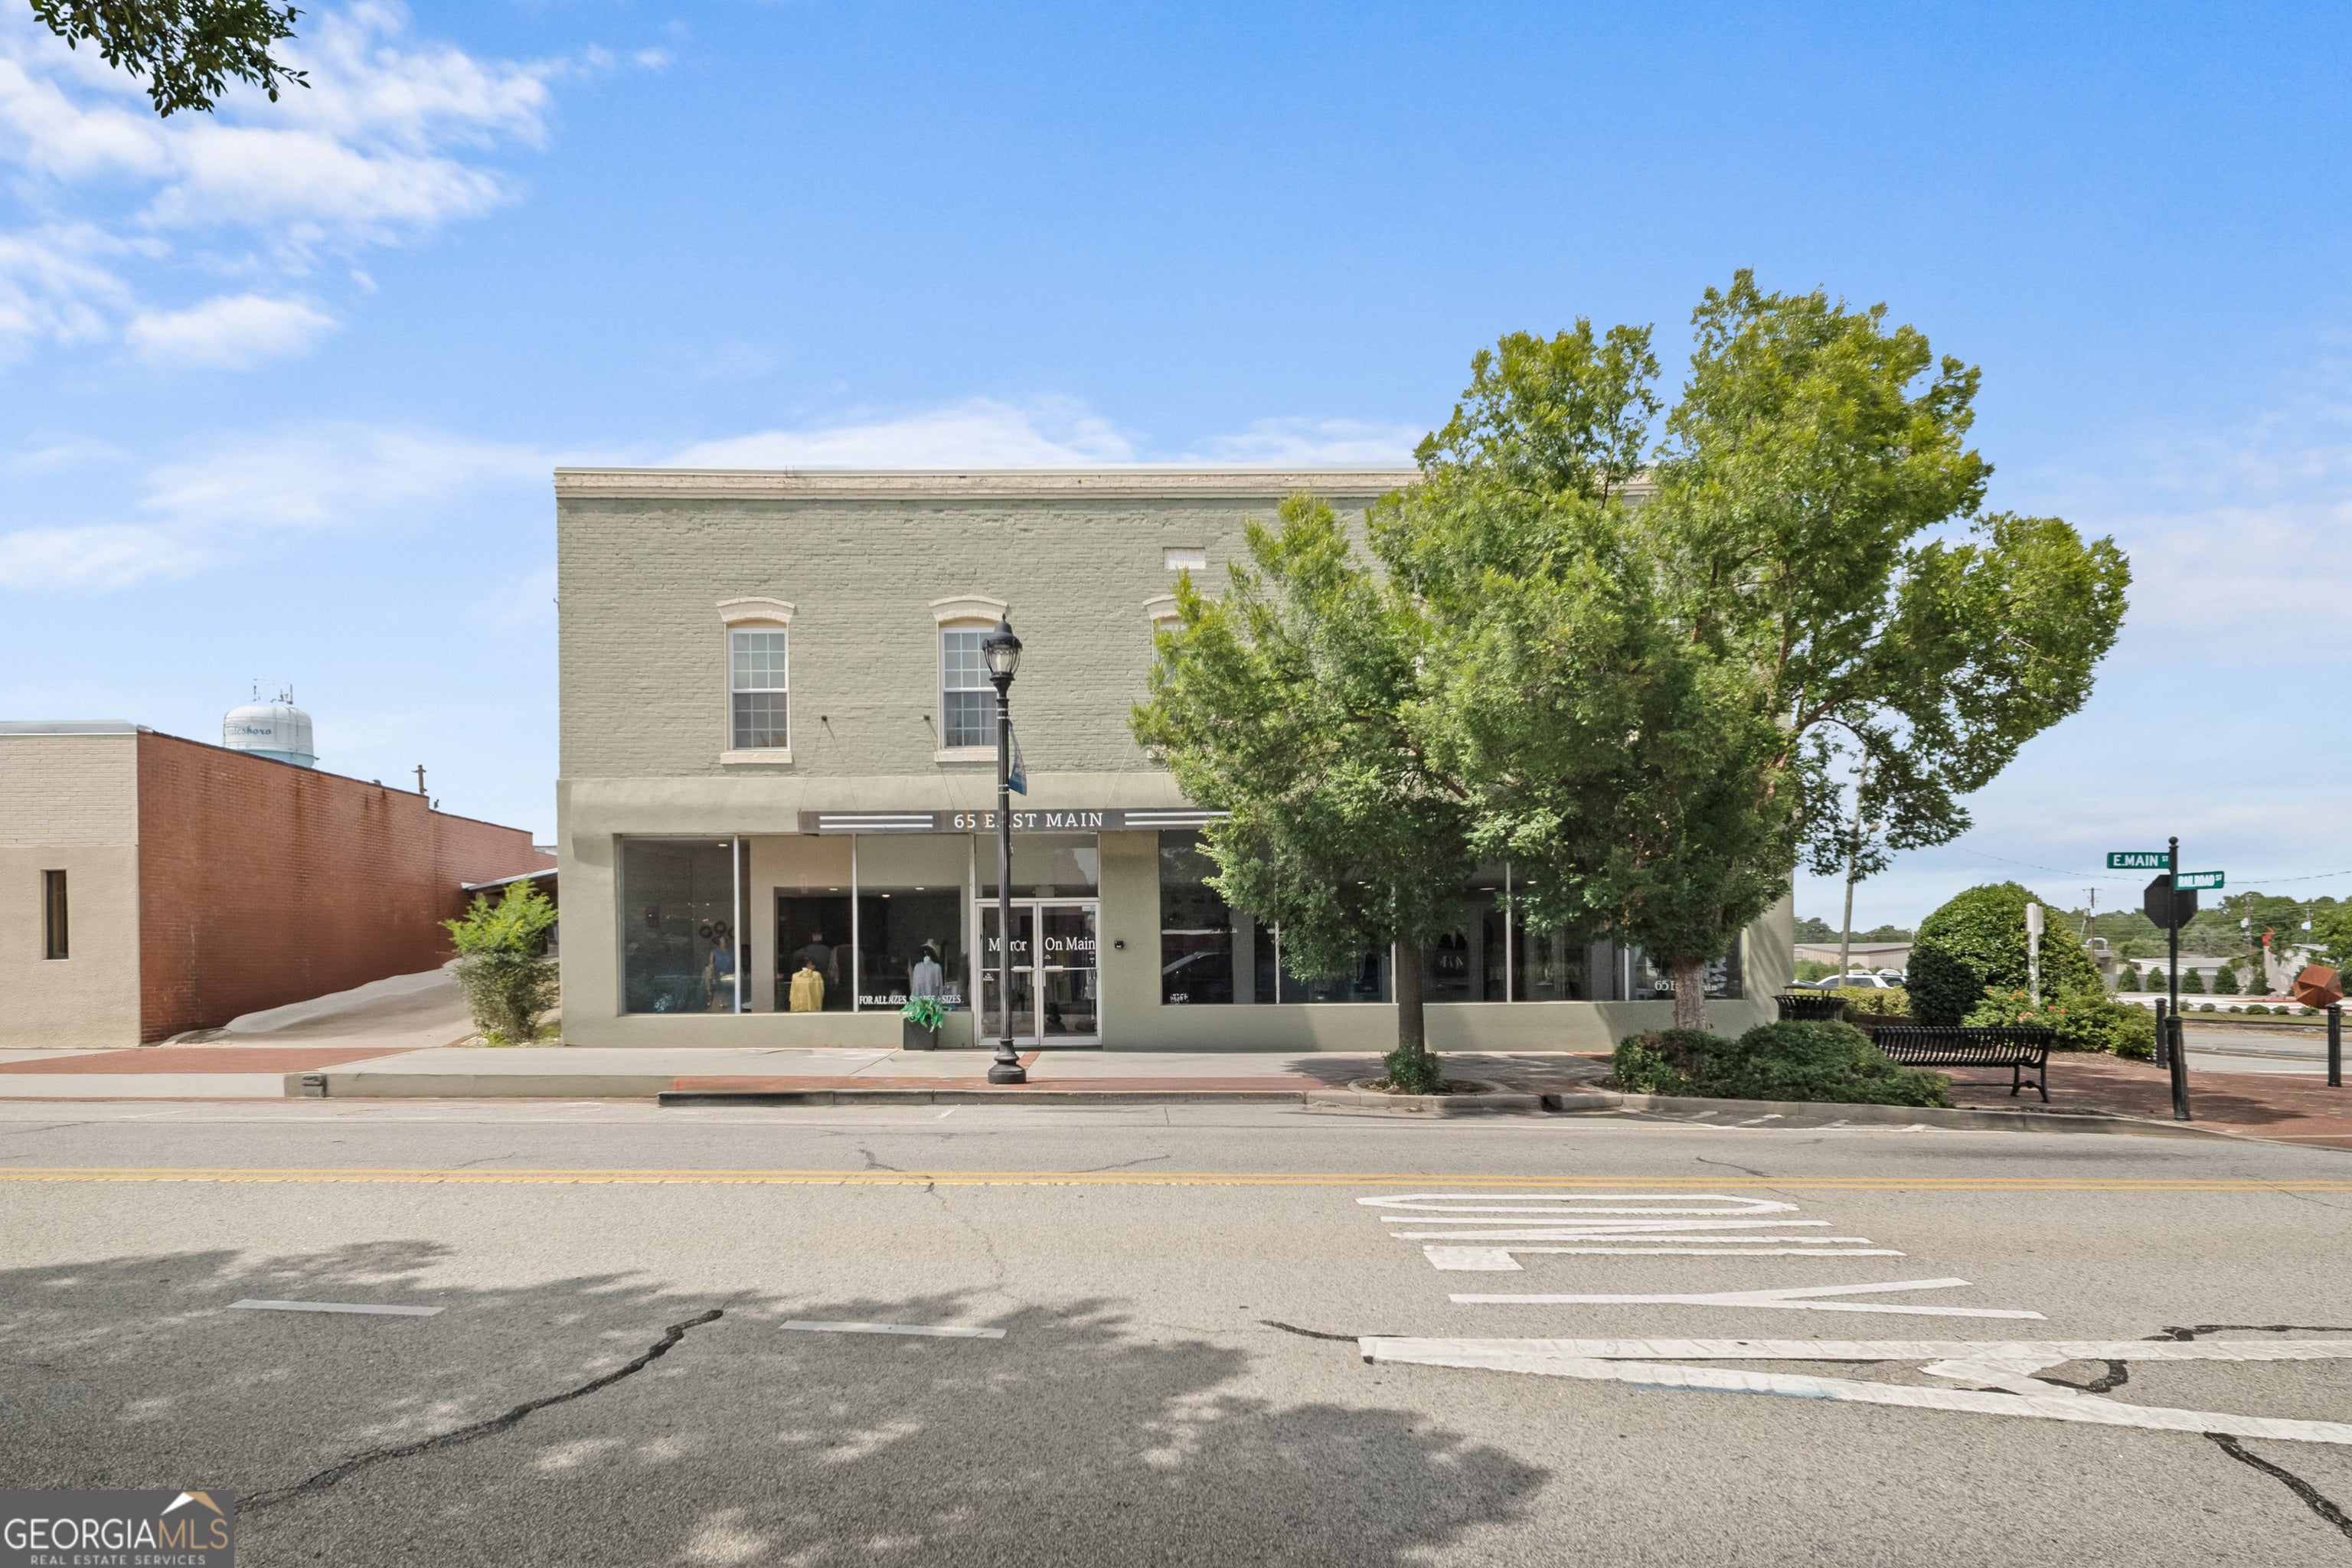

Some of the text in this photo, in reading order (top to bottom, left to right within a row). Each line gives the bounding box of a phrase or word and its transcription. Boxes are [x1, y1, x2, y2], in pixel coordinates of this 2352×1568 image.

[954, 812, 1102, 828] 65 EST MAIN
[2177, 875, 2215, 887] RAILROAD
[988, 936, 1096, 951] Mror On Main
[1655, 980, 1669, 991] 65
[859, 995, 873, 1004] FOR
[874, 995, 887, 1004] ALL
[1355, 1194, 2049, 1321] ONLY
